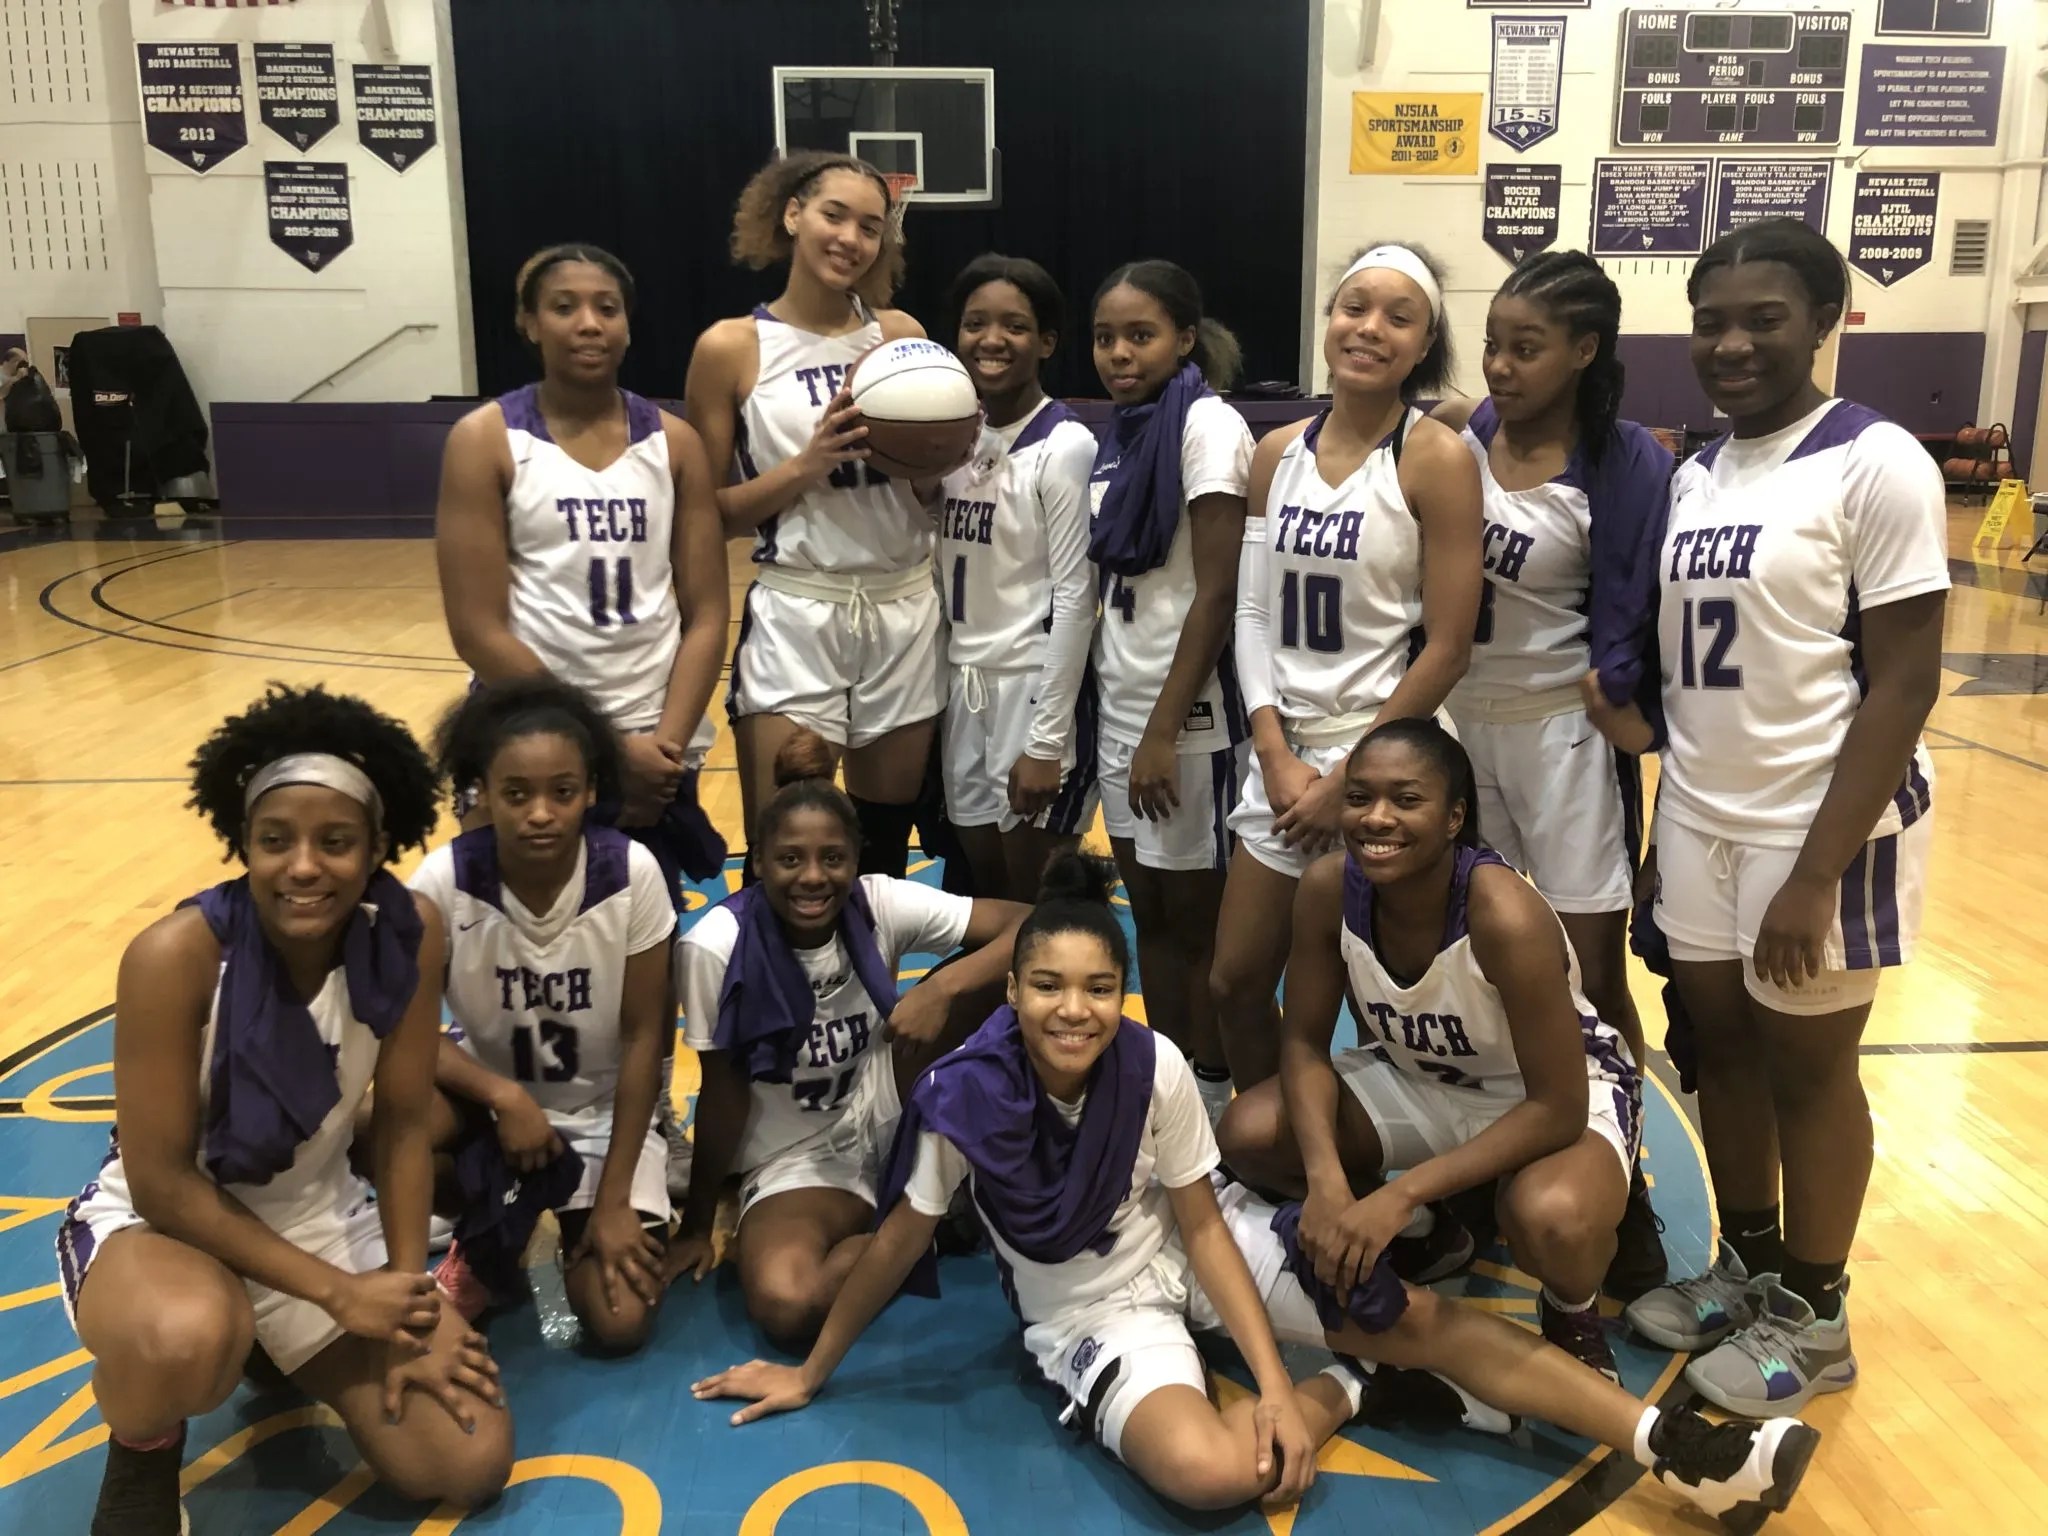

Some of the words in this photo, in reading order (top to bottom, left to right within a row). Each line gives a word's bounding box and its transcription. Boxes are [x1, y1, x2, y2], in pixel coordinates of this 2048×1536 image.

[1638, 15, 1677, 29] HOME
[1797, 16, 1849, 30] VISITOR
[1500, 25, 1536, 36] NEWARK
[1539, 25, 1559, 36] TECH
[173, 59, 232, 68] BASKETBALL
[1718, 56, 1737, 64] POSS
[1709, 66, 1745, 76] PERIOD
[1648, 73, 1681, 84] BONUS
[1790, 74, 1822, 84] BONUS
[179, 86, 186, 94] 2
[259, 87, 337, 100] CHAMPIONS
[1641, 93, 1672, 104] FOULS
[1701, 93, 1737, 104] PLAYER
[1745, 93, 1775, 104] FOULS
[1796, 93, 1826, 104] FOULS
[147, 97, 241, 112] CHAMPIONS
[273, 108, 326, 117] 2014-2015
[358, 108, 434, 121] CHAMPIONS
[1395, 104, 1438, 117] NJSIAA
[1368, 119, 1464, 132] SPORTSMANSHIP
[180, 128, 215, 141] 2013
[1643, 133, 1663, 142] WON
[1719, 133, 1744, 142] GAME
[1797, 133, 1817, 142] WON
[1396, 135, 1435, 147] AWARD
[1392, 150, 1439, 161] 2011-2012
[1868, 178, 1906, 186] NEWARK
[1907, 178, 1928, 186] TECH
[1504, 186, 1541, 195] SOCCER
[1883, 188, 1935, 196] BASKETBALL
[1505, 197, 1539, 206] NJTAC
[271, 207, 348, 220] CHAMPIONS
[1487, 207, 1556, 219] CHAMPIONS
[1881, 204, 1911, 213] NJTIL
[1855, 215, 1934, 228] CHAMPIONS
[1497, 225, 1544, 235] 2015-2016
[1855, 228, 1911, 236] UNDEFEATED
[1859, 248, 1923, 259] 2008-2009
[556, 497, 648, 542] TECH
[944, 498, 997, 545] TECH
[1275, 503, 1365, 560] TECH
[1482, 519, 1535, 583] CH
[1669, 524, 1764, 582] TECH
[587, 557, 640, 626] 11
[952, 554, 968, 624] 1
[1280, 568, 1345, 654] 10
[1681, 597, 1745, 690] 12
[1192, 706, 1204, 714] M
[495, 966, 593, 1013] TECH
[1366, 1001, 1480, 1057] TECH
[807, 1012, 871, 1068] ECH
[512, 1019, 580, 1083] 13
